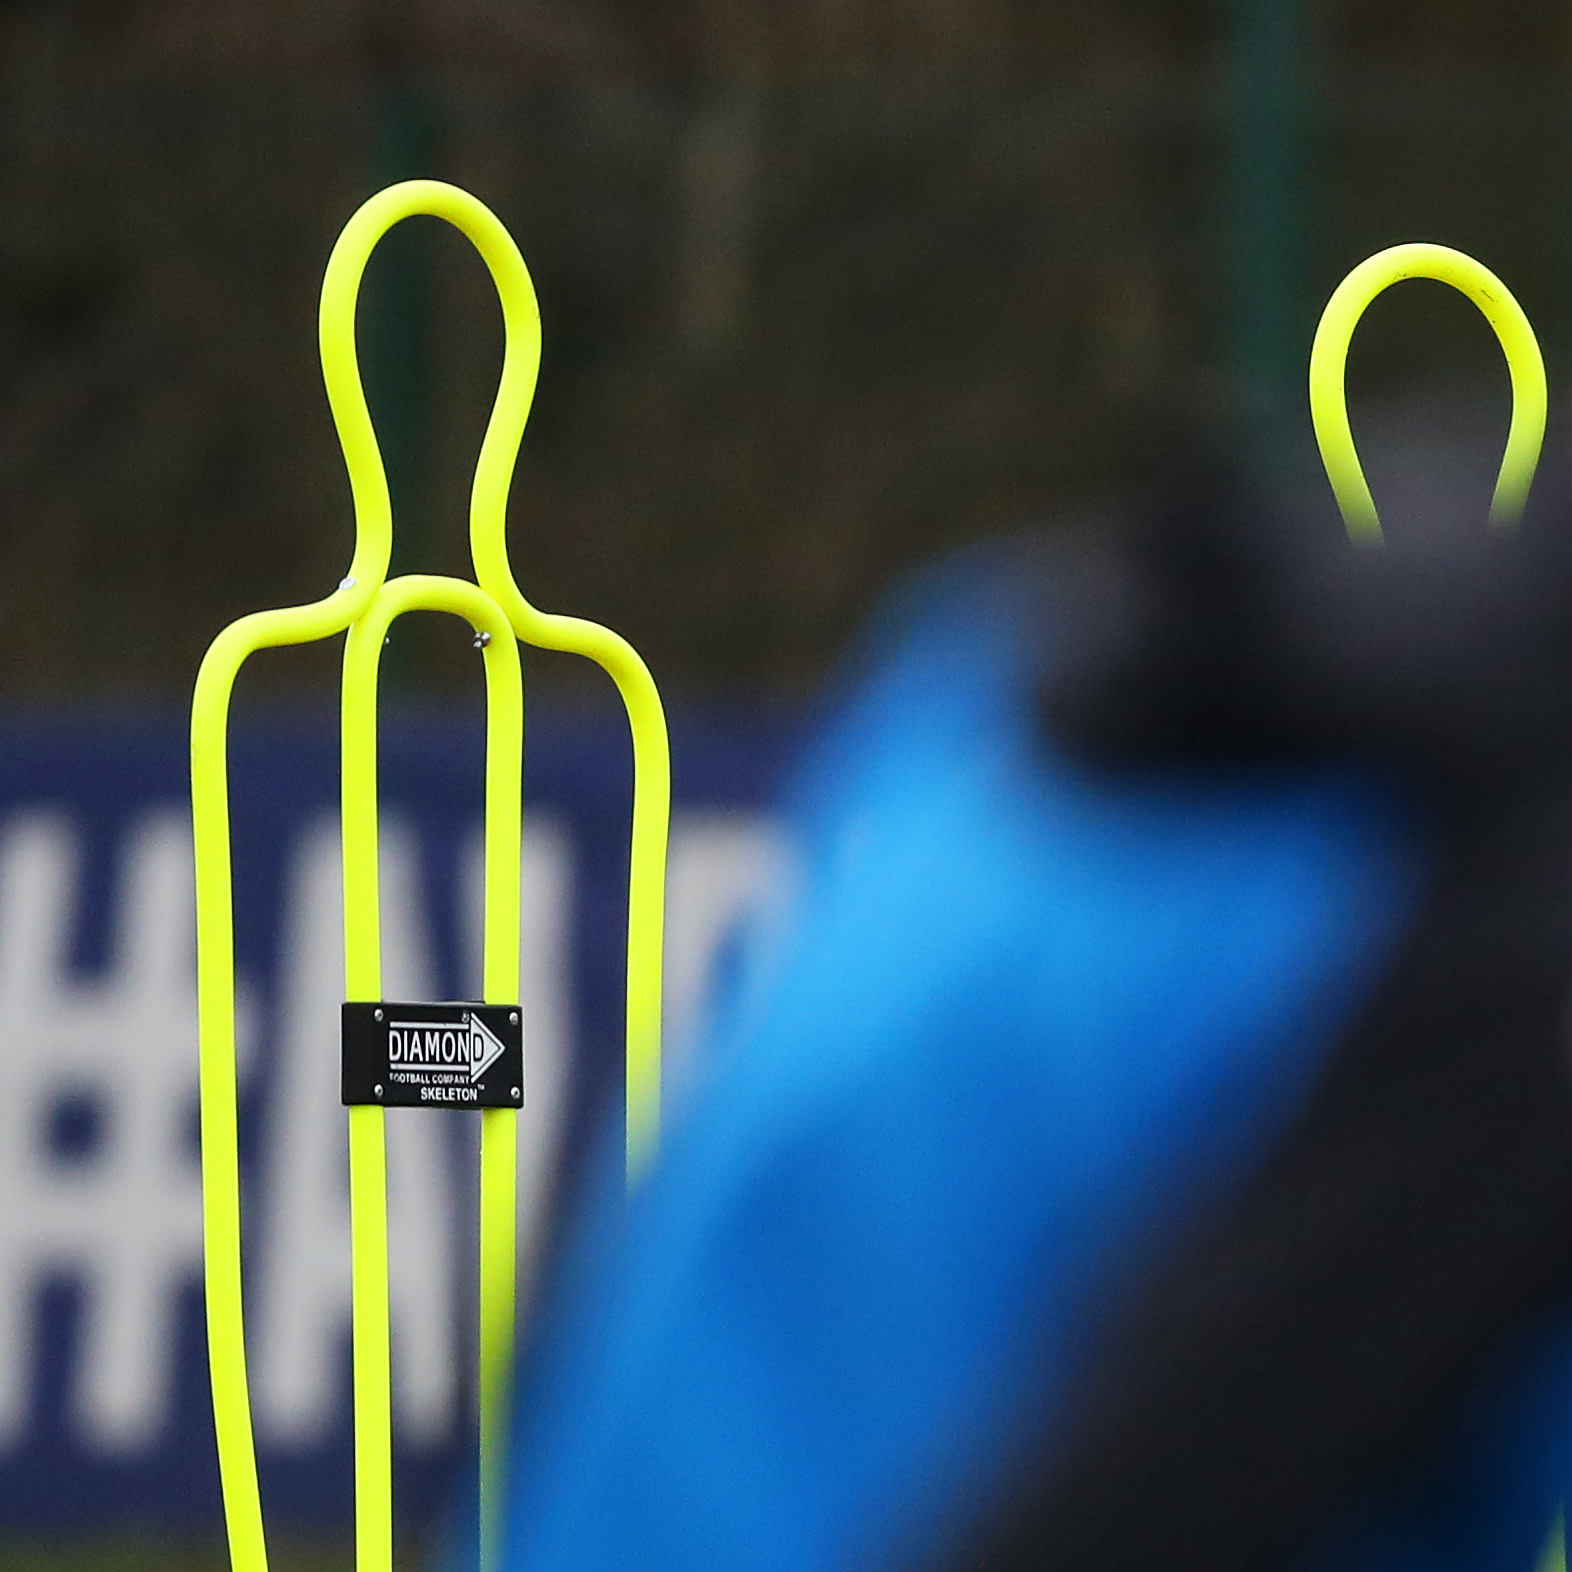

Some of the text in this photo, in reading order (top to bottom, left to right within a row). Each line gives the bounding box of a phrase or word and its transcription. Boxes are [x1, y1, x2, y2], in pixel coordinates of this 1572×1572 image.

[389, 1030, 484, 1062] DIAMOND
[389, 1073, 469, 1086] FOOTBALL COMPANY
[420, 1086, 478, 1101] SKELETON
